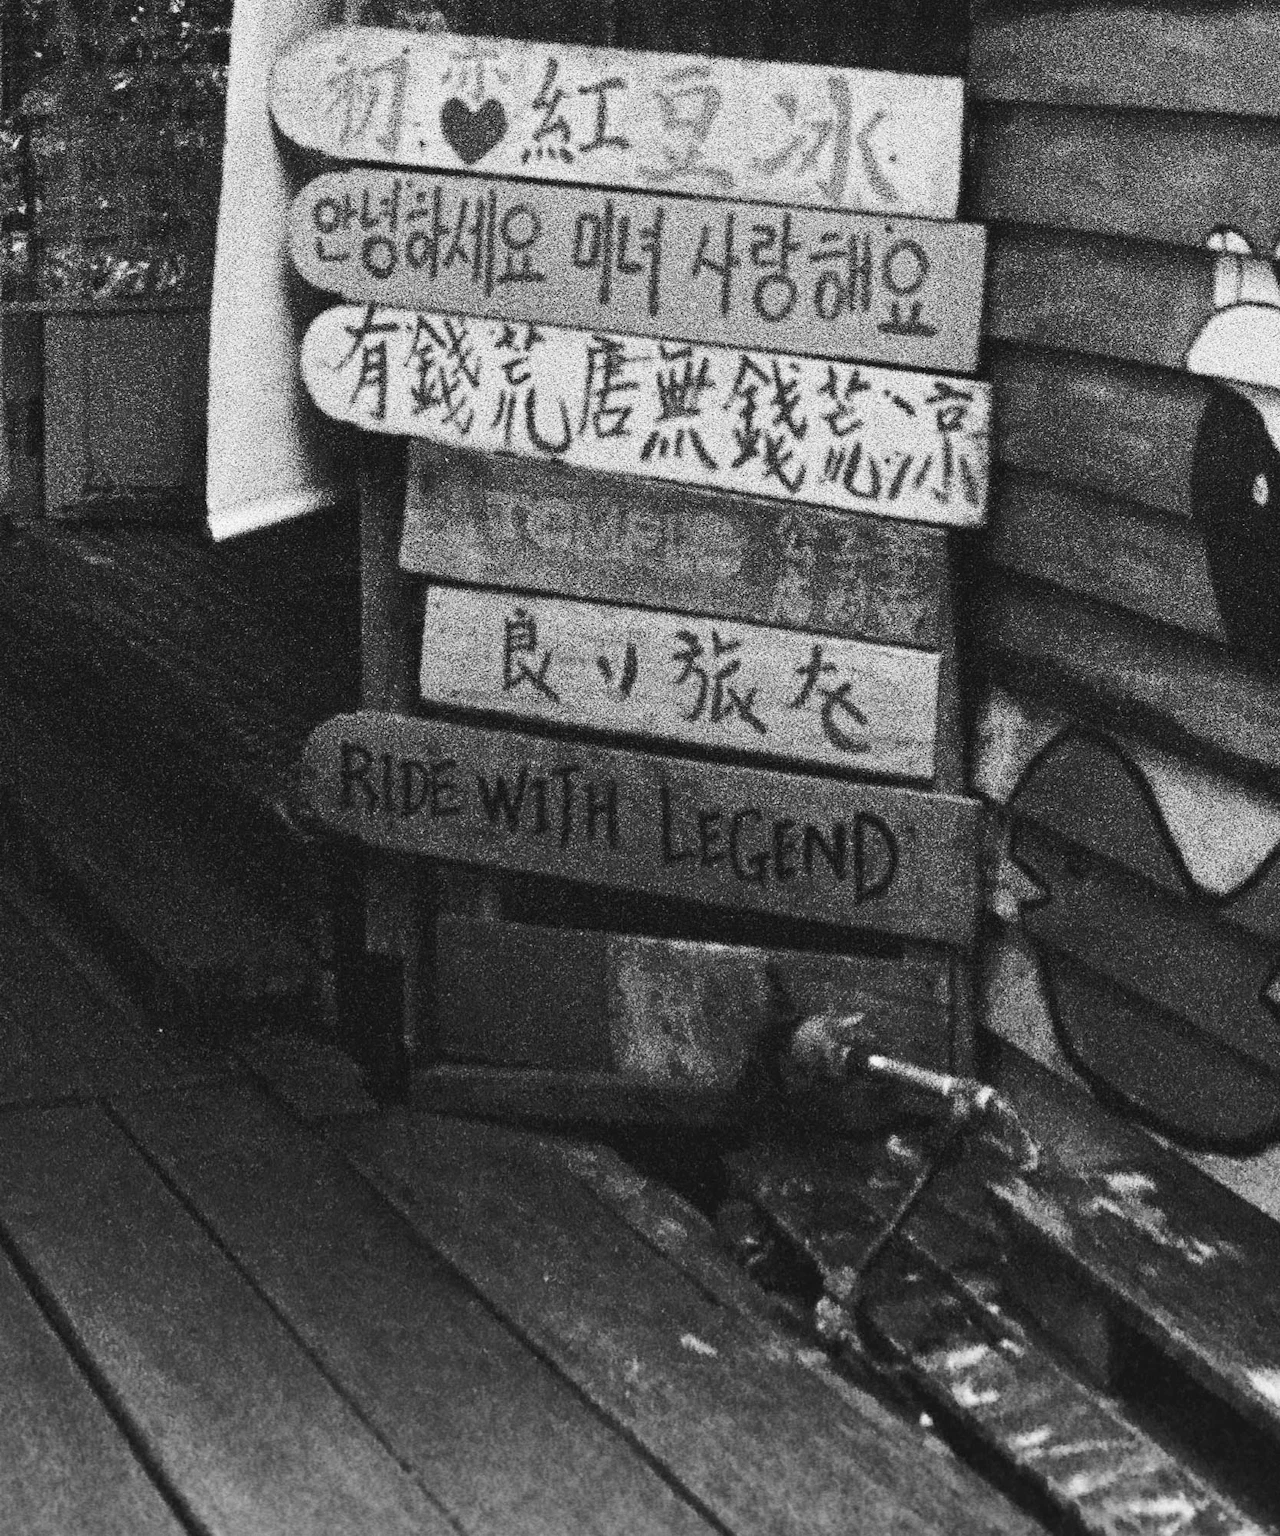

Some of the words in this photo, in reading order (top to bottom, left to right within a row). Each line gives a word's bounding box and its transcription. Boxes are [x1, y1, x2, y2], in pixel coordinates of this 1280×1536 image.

[313, 179, 546, 298] 안녕하세요
[573, 200, 665, 317] 미녀
[693, 212, 938, 338] 사랑해요
[339, 742, 460, 819] RIDE
[477, 763, 619, 851] WITH
[660, 781, 898, 904] LEGEND
